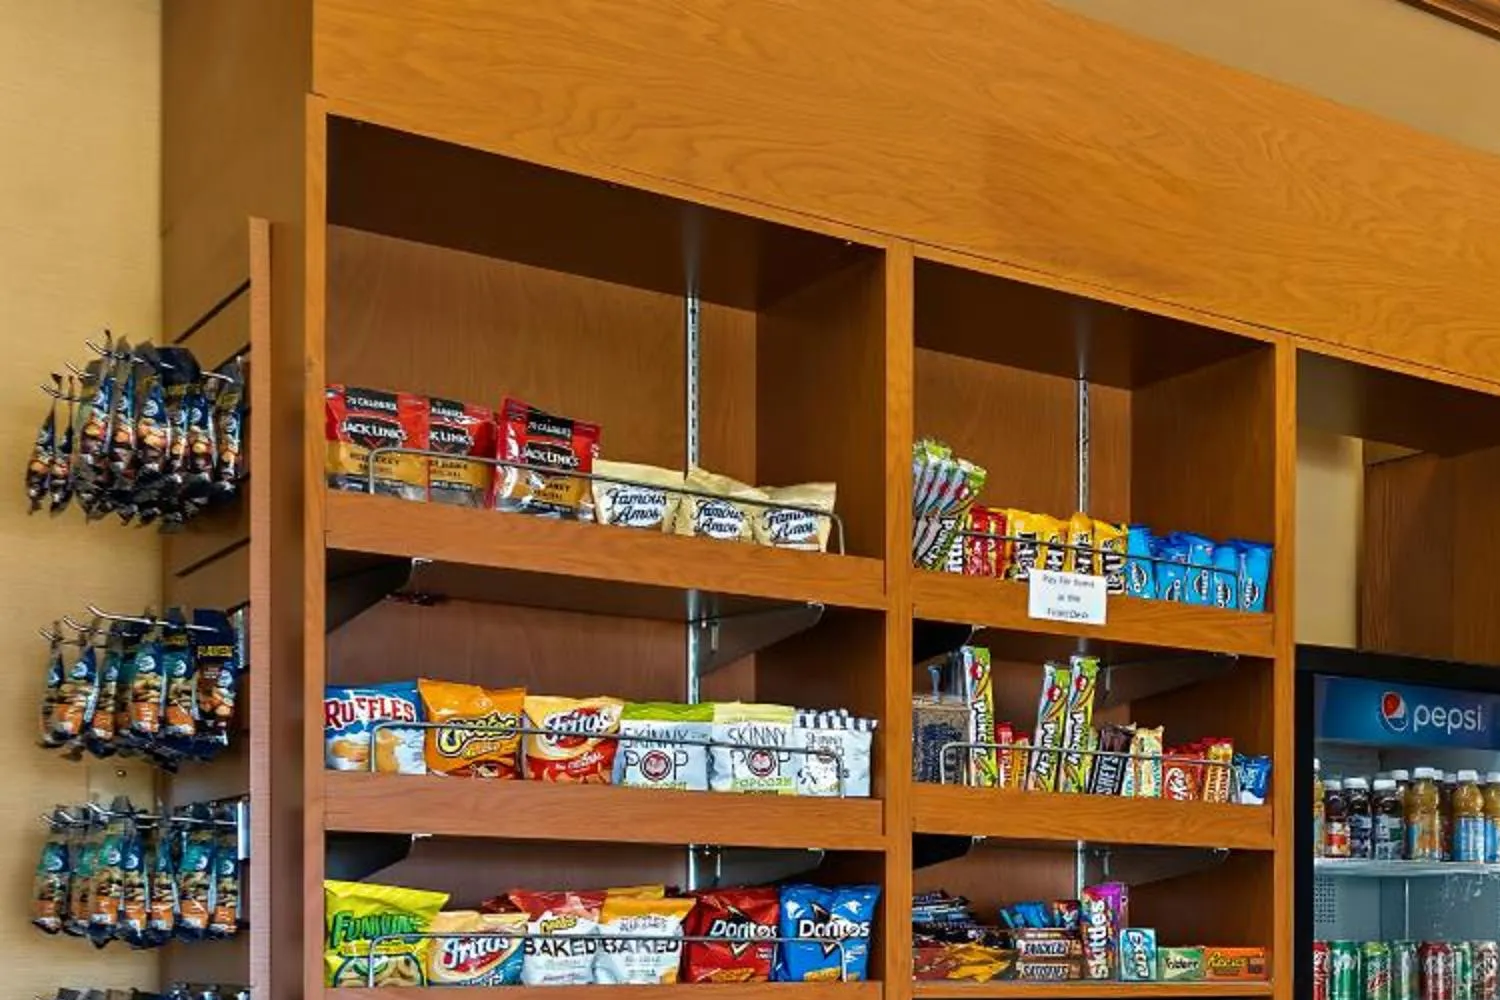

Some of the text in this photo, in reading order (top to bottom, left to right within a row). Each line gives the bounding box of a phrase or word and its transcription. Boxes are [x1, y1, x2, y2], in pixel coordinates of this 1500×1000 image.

[606, 487, 668, 507] Famous
[610, 504, 661, 528] Amos
[691, 500, 746, 521] Famous
[325, 697, 416, 730] RUFFLES
[1413, 704, 1484, 735] pepsi
[727, 726, 787, 748] SKINNY
[709, 919, 778, 939] Doritos
[799, 919, 871, 939] Doritos
[524, 936, 596, 958] BAKED
